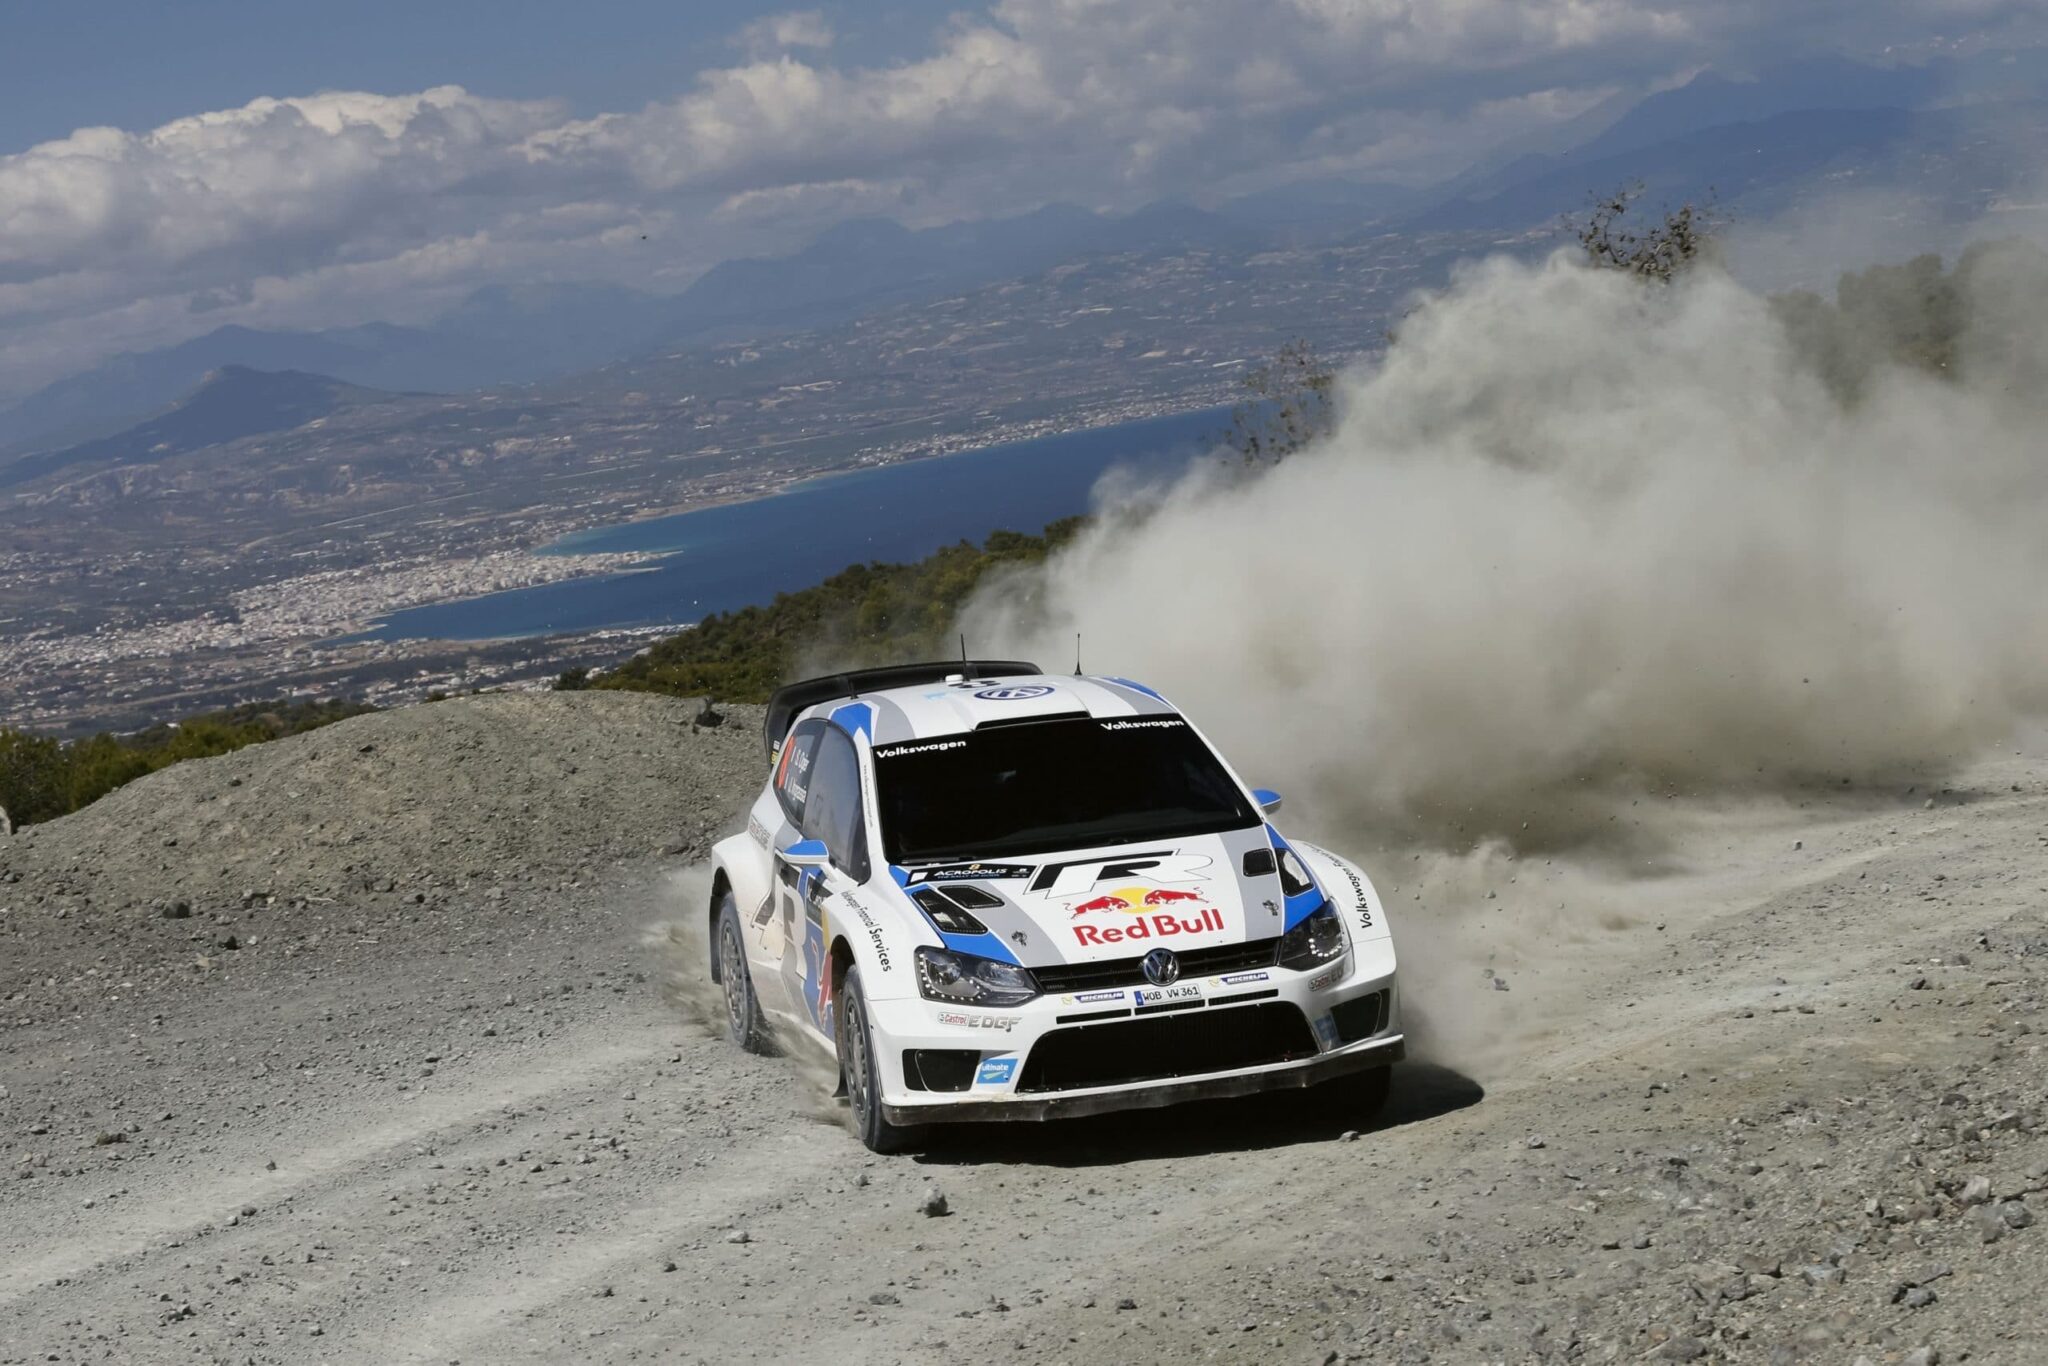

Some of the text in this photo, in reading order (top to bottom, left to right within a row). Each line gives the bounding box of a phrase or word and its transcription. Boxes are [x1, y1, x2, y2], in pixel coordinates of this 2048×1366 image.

[1100, 719, 1184, 731] Volkswagen
[877, 741, 966, 758] Volkswagen
[934, 868, 1008, 877] ACROPOLIS
[1341, 866, 1373, 929] Volkswagen
[1072, 908, 1225, 947] Red Bull
[868, 927, 892, 972] Services
[1226, 973, 1267, 984] MICHELIN
[1079, 991, 1123, 1002] MICHELIN
[1142, 986, 1199, 1001] WOB VW 361
[944, 1014, 968, 1025] Castrol
[980, 1063, 1009, 1072] ultimate
